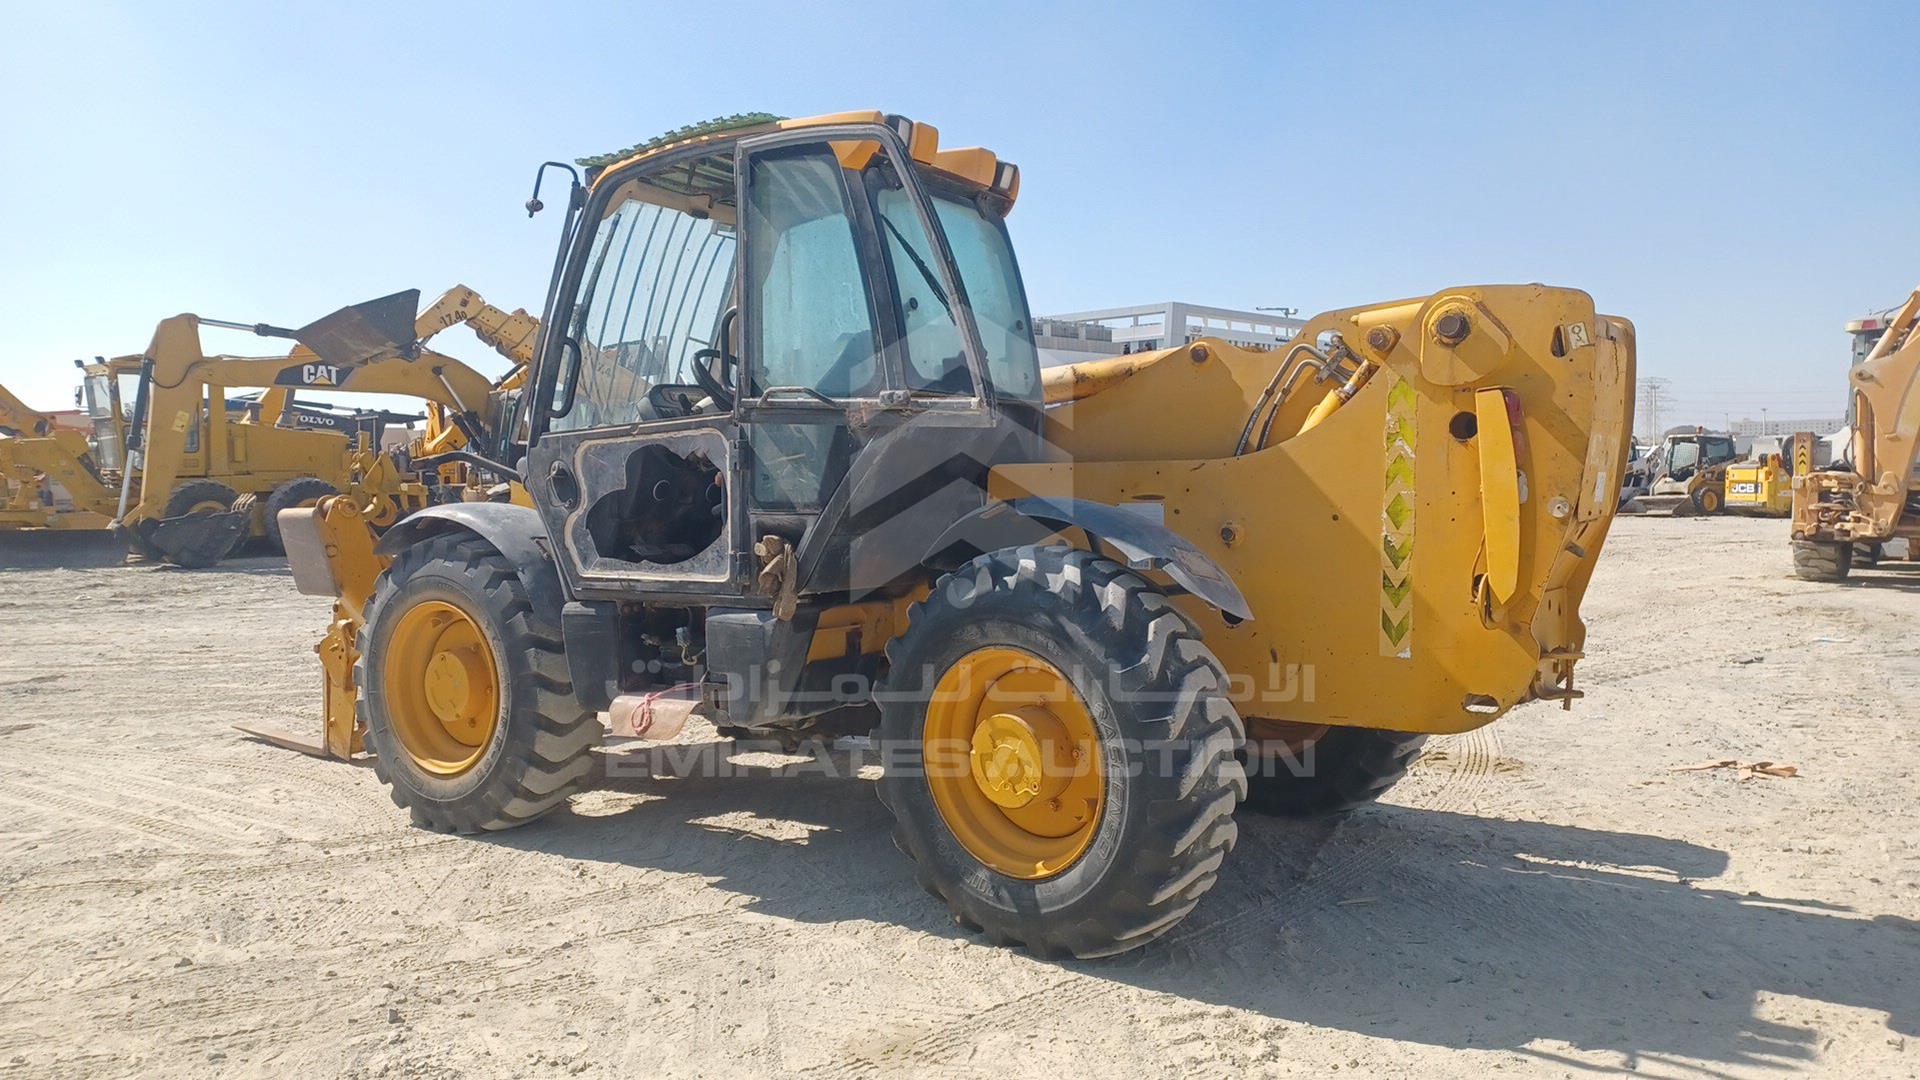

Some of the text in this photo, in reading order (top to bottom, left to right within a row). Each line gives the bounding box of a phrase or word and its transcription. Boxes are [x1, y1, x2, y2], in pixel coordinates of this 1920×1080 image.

[302, 364, 340, 385] CAT
[297, 414, 335, 426] OLVO
[1731, 483, 1755, 493] JCB
